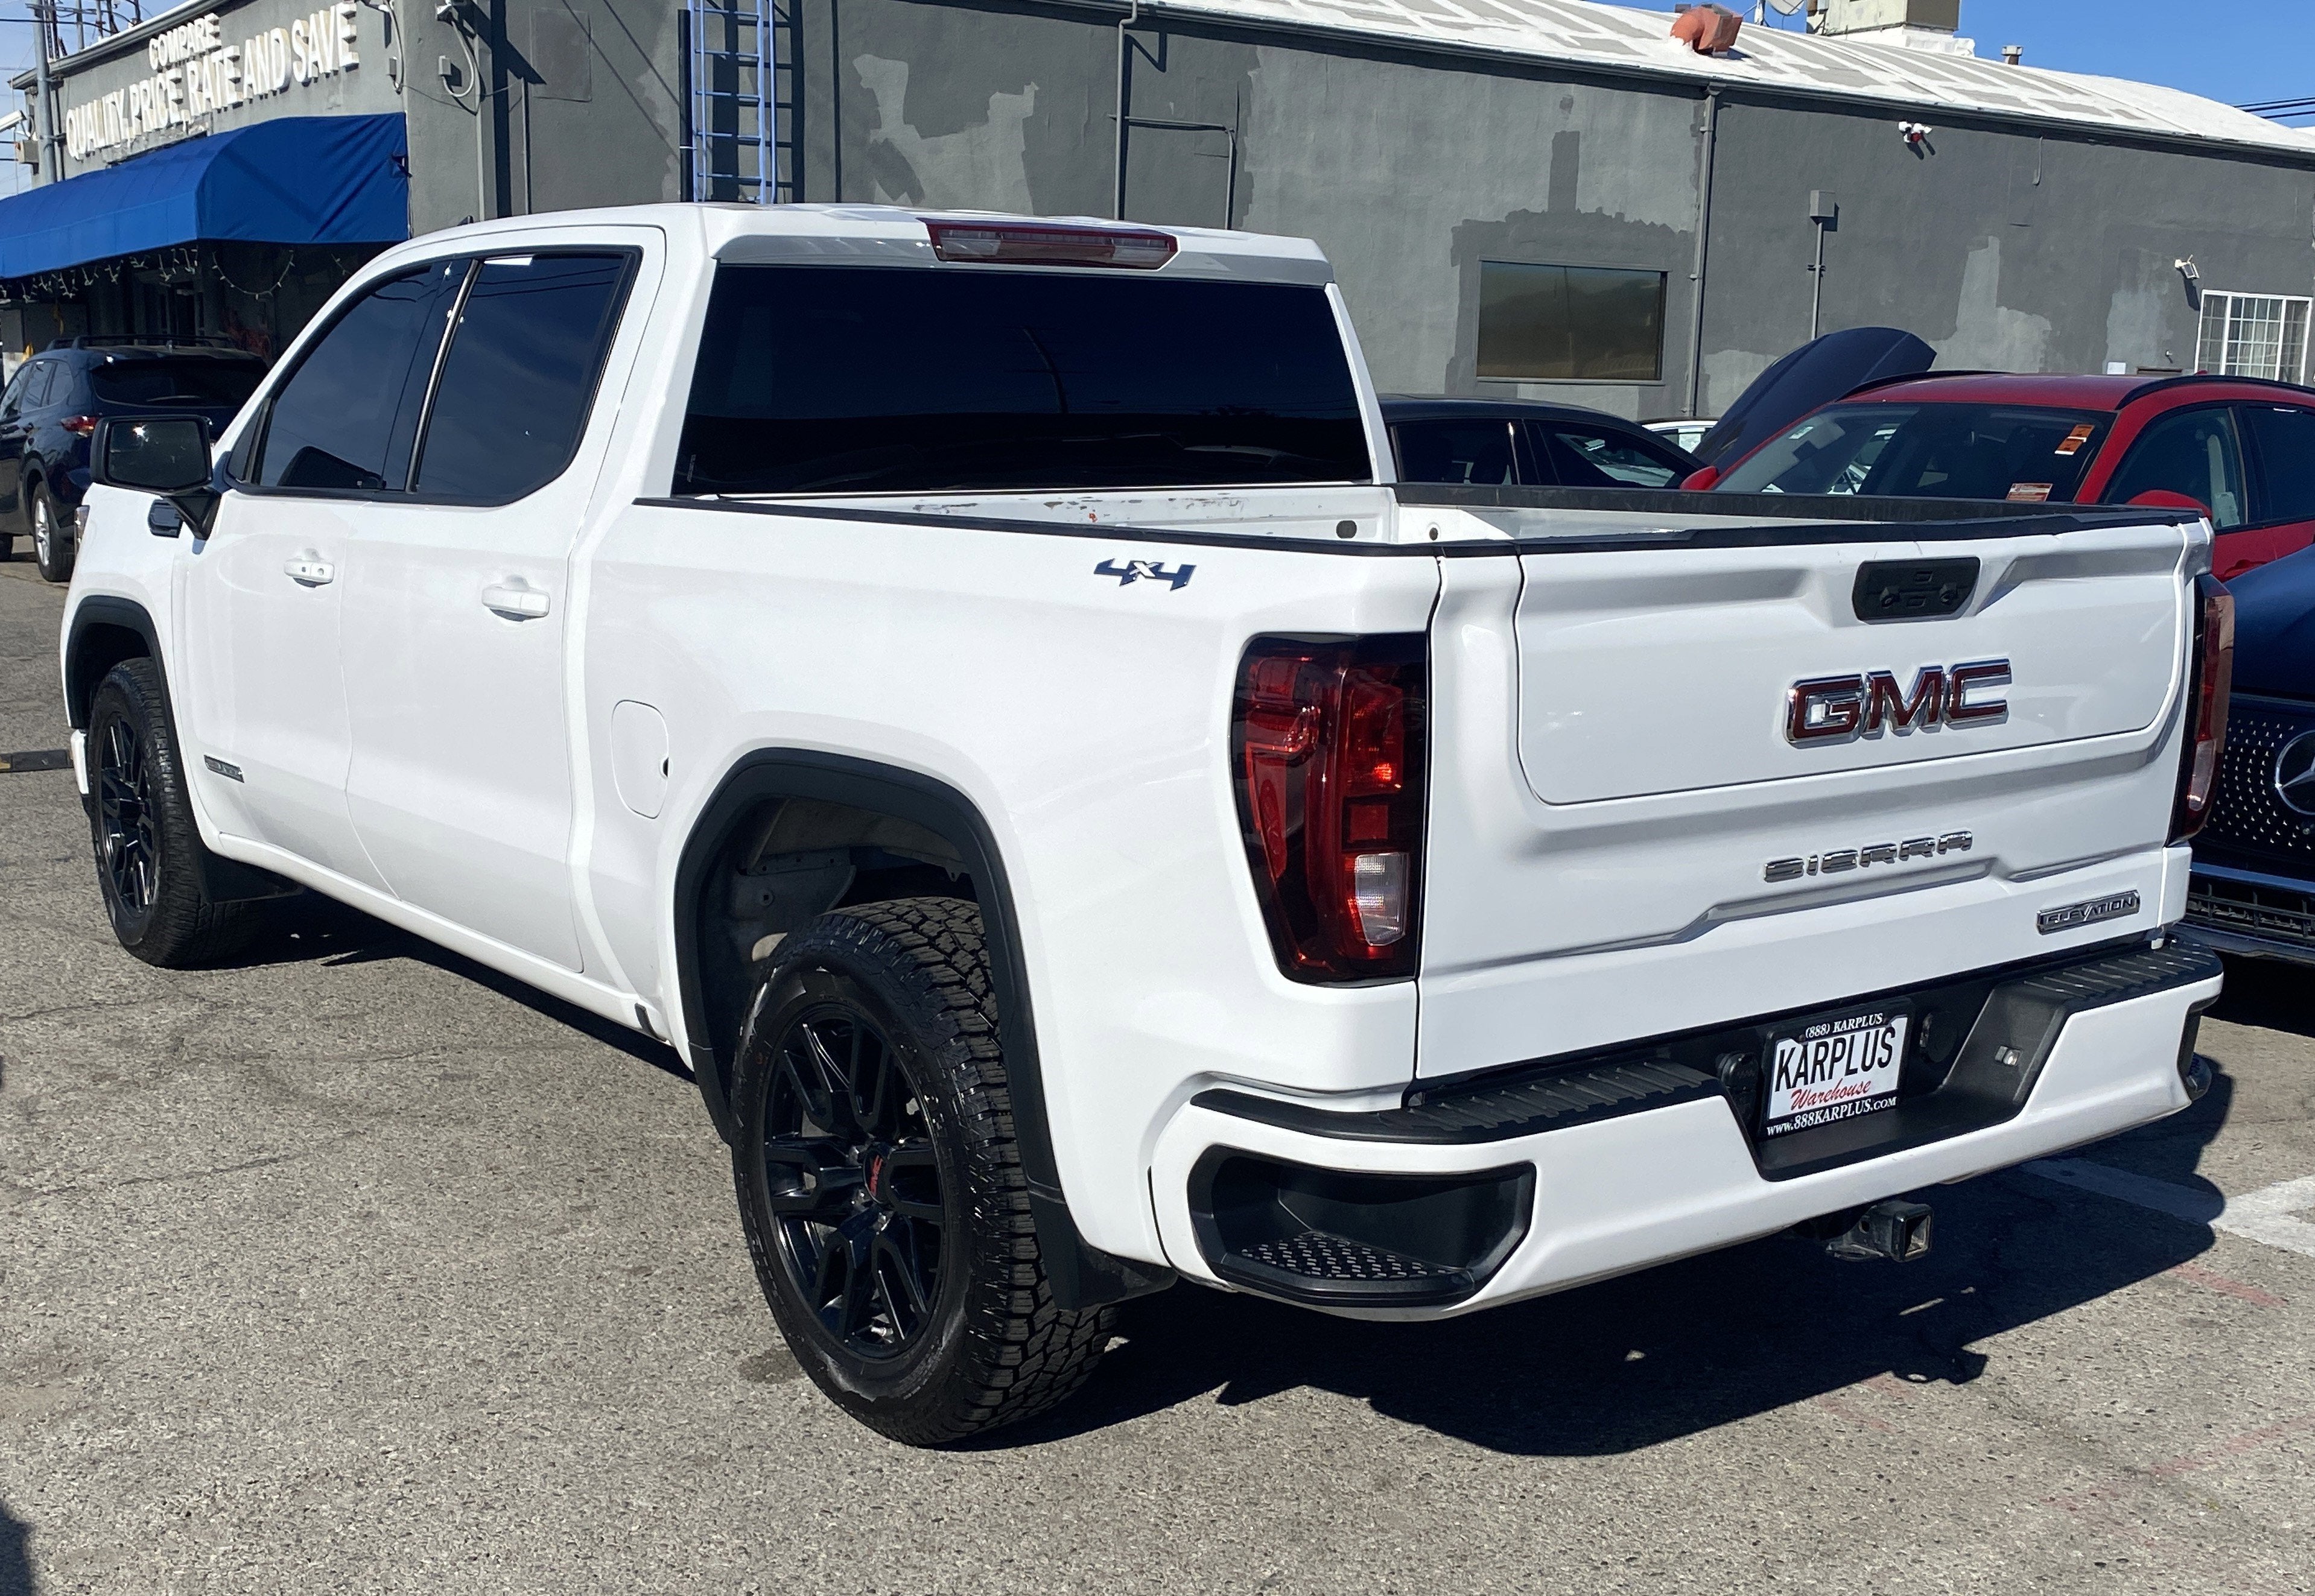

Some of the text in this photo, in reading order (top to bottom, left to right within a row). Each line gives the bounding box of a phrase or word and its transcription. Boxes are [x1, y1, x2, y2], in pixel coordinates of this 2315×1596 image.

[149, 13, 221, 71] COMPARE
[186, 45, 243, 116] RATE
[243, 27, 291, 100] AND
[291, 2, 360, 83] SAVE
[1783, 658, 2012, 749] GMC
[1764, 831, 1972, 883] SIERRA
[2044, 896, 2133, 925] ELEVATION
[1805, 1013, 1883, 1039] (888) KARPLUS
[1775, 1025, 1896, 1092] KARPLUS
[1790, 1078, 1872, 1110] Warehouse
